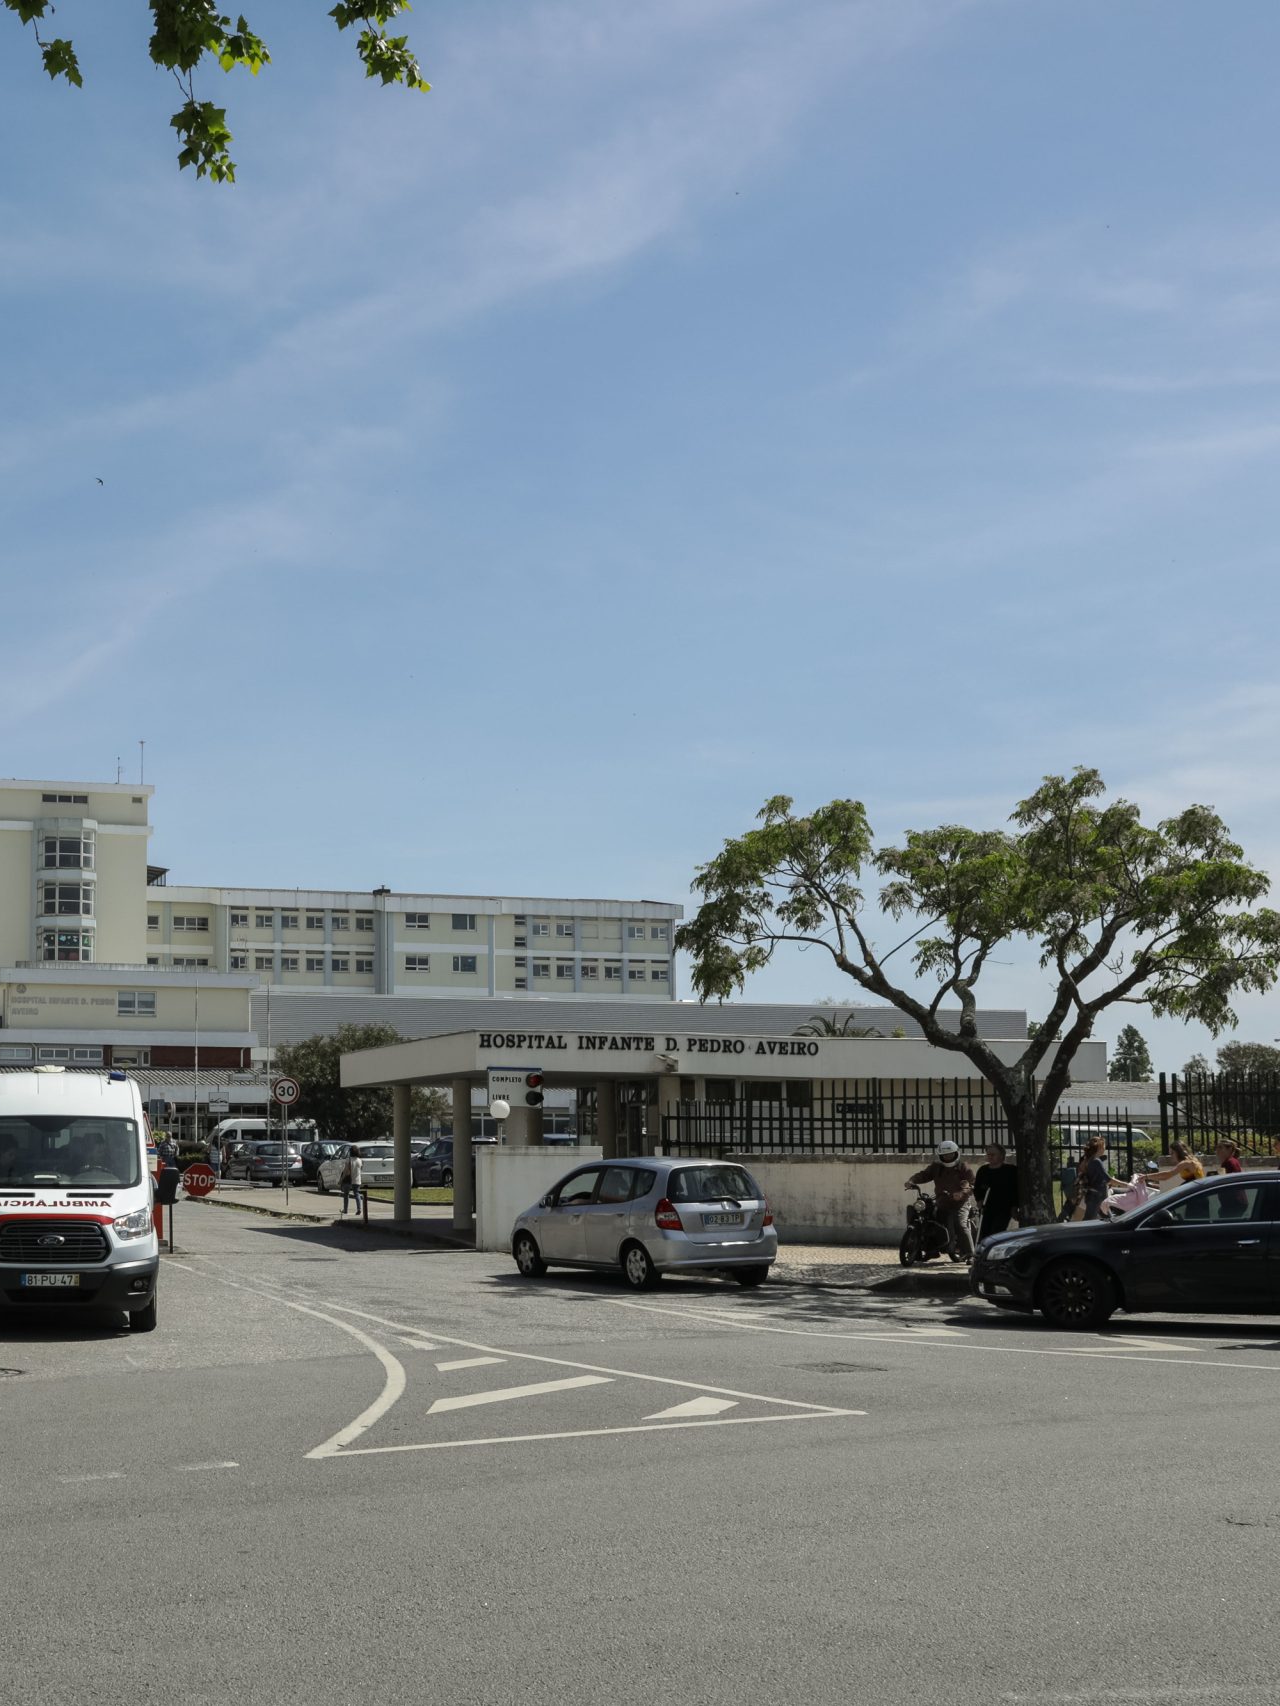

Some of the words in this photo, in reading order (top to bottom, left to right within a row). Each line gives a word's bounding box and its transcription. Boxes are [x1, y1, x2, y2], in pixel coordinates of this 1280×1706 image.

[479, 1033, 568, 1050] HOSPITAL
[577, 1035, 655, 1051] INFANTE
[665, 1037, 680, 1052] D.
[687, 1037, 745, 1054] PEDRO
[755, 1041, 819, 1056] AVEIRO
[278, 1086, 295, 1097] 30
[184, 1173, 216, 1187] STOP
